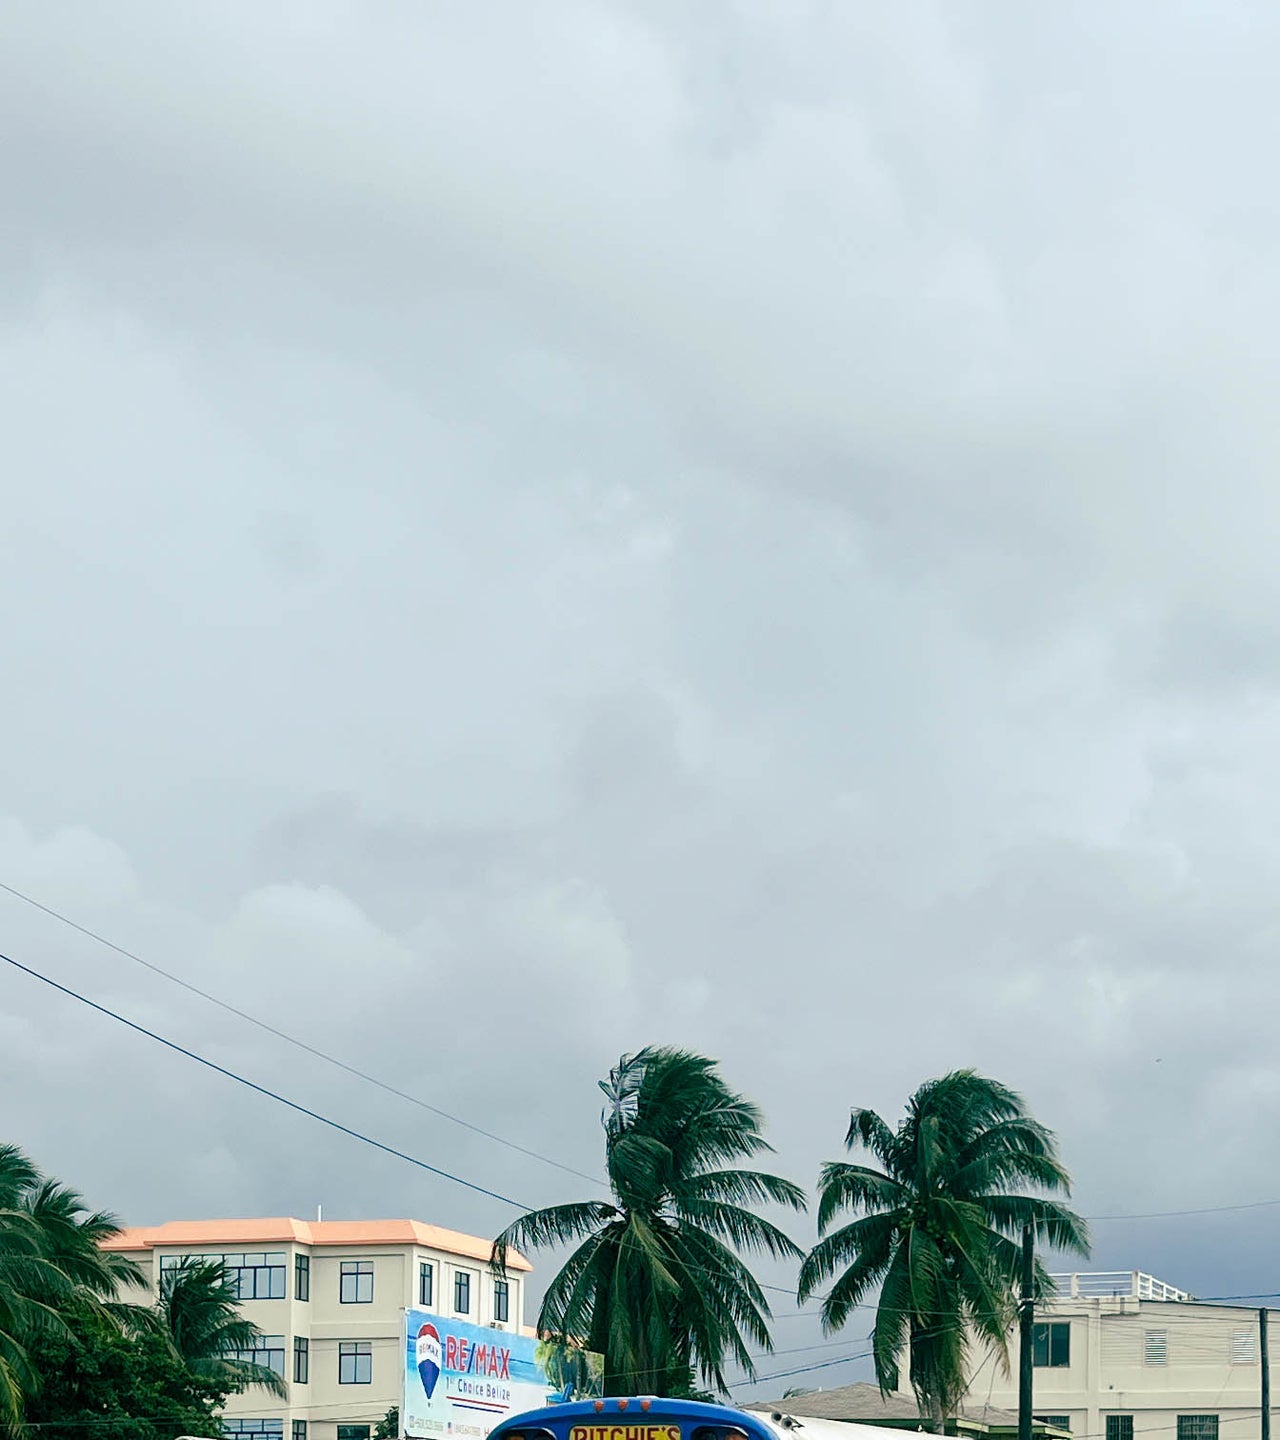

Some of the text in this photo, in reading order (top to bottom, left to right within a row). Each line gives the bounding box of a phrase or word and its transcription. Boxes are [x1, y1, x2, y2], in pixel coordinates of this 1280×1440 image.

[445, 1335, 511, 1380] RE/MAX
[457, 1378, 484, 1396] Choice
[485, 1383, 511, 1401] Belize
